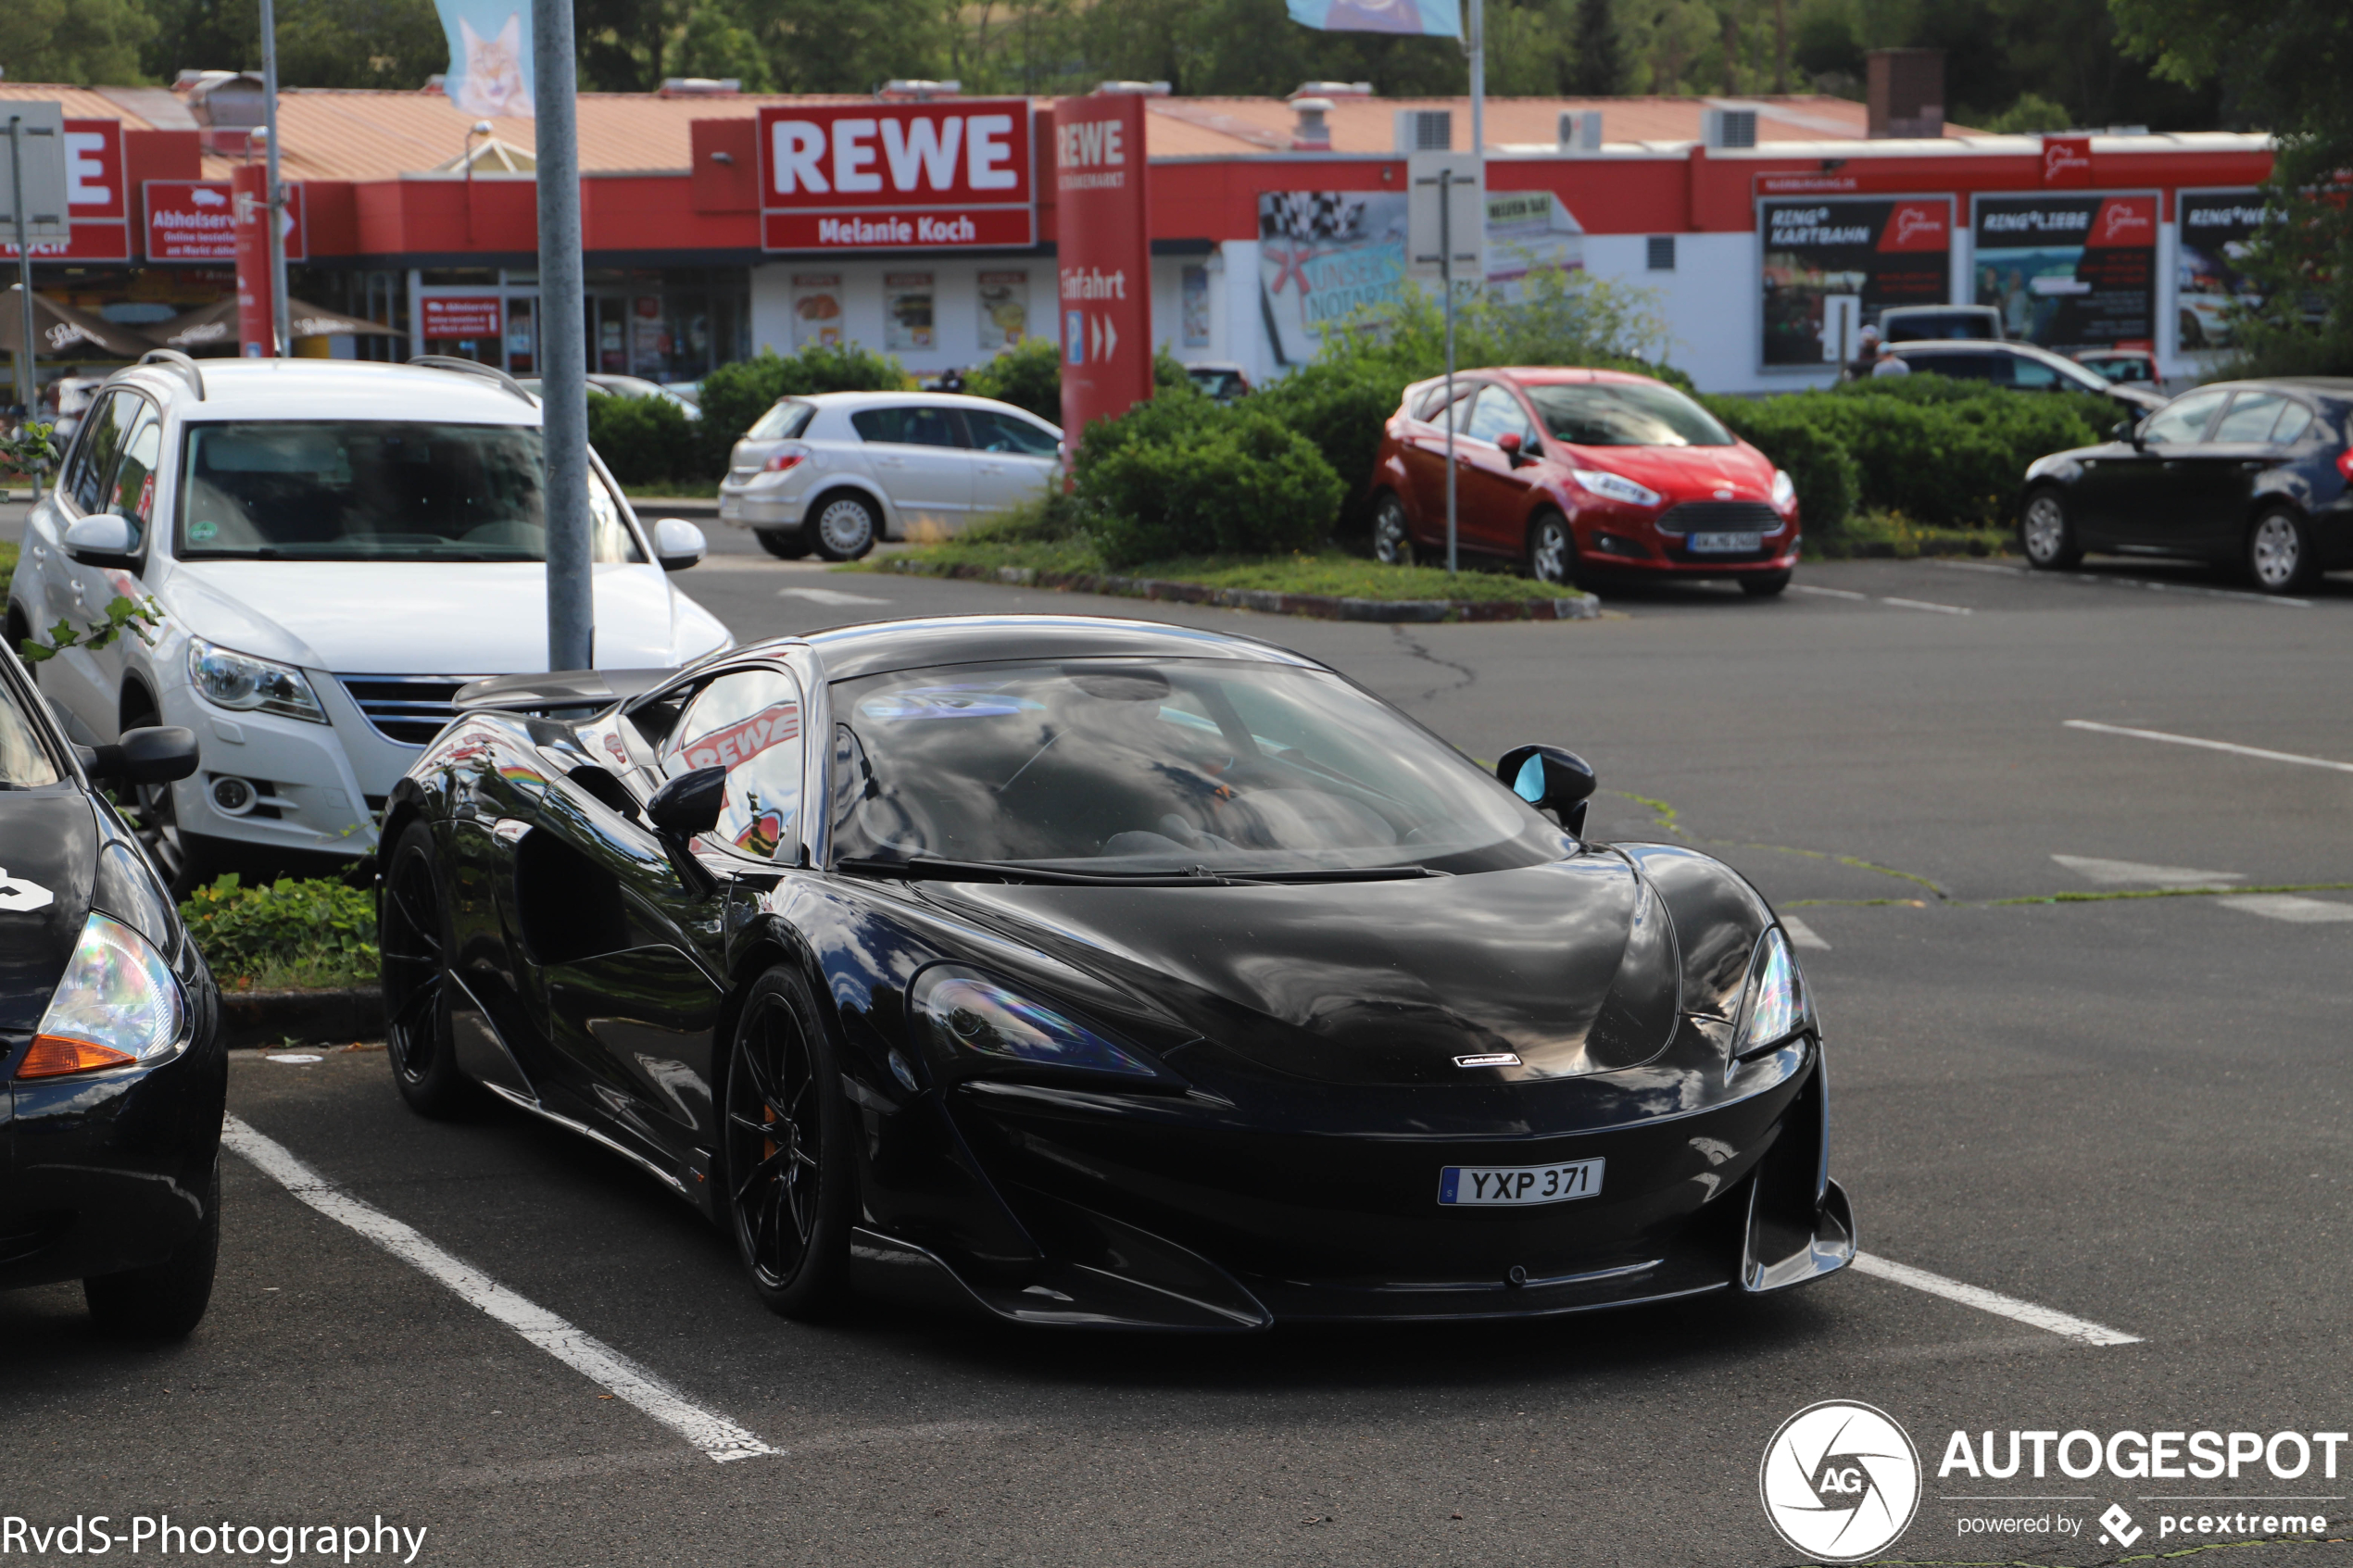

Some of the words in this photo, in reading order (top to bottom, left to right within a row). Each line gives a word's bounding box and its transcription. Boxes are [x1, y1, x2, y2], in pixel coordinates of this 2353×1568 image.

[772, 114, 1018, 194] REWE
[1058, 119, 1125, 168] REWE
[152, 209, 237, 229] Abholserv
[819, 216, 912, 244] Melanie
[918, 215, 975, 241] Koch
[1770, 226, 1870, 245] KARTBAHN
[1311, 256, 1385, 293] UNSER
[690, 713, 799, 769] REWE
[1446, 1189, 1453, 1198] S
[1471, 1173, 1535, 1199] YXP
[1541, 1165, 1589, 1197] 371
